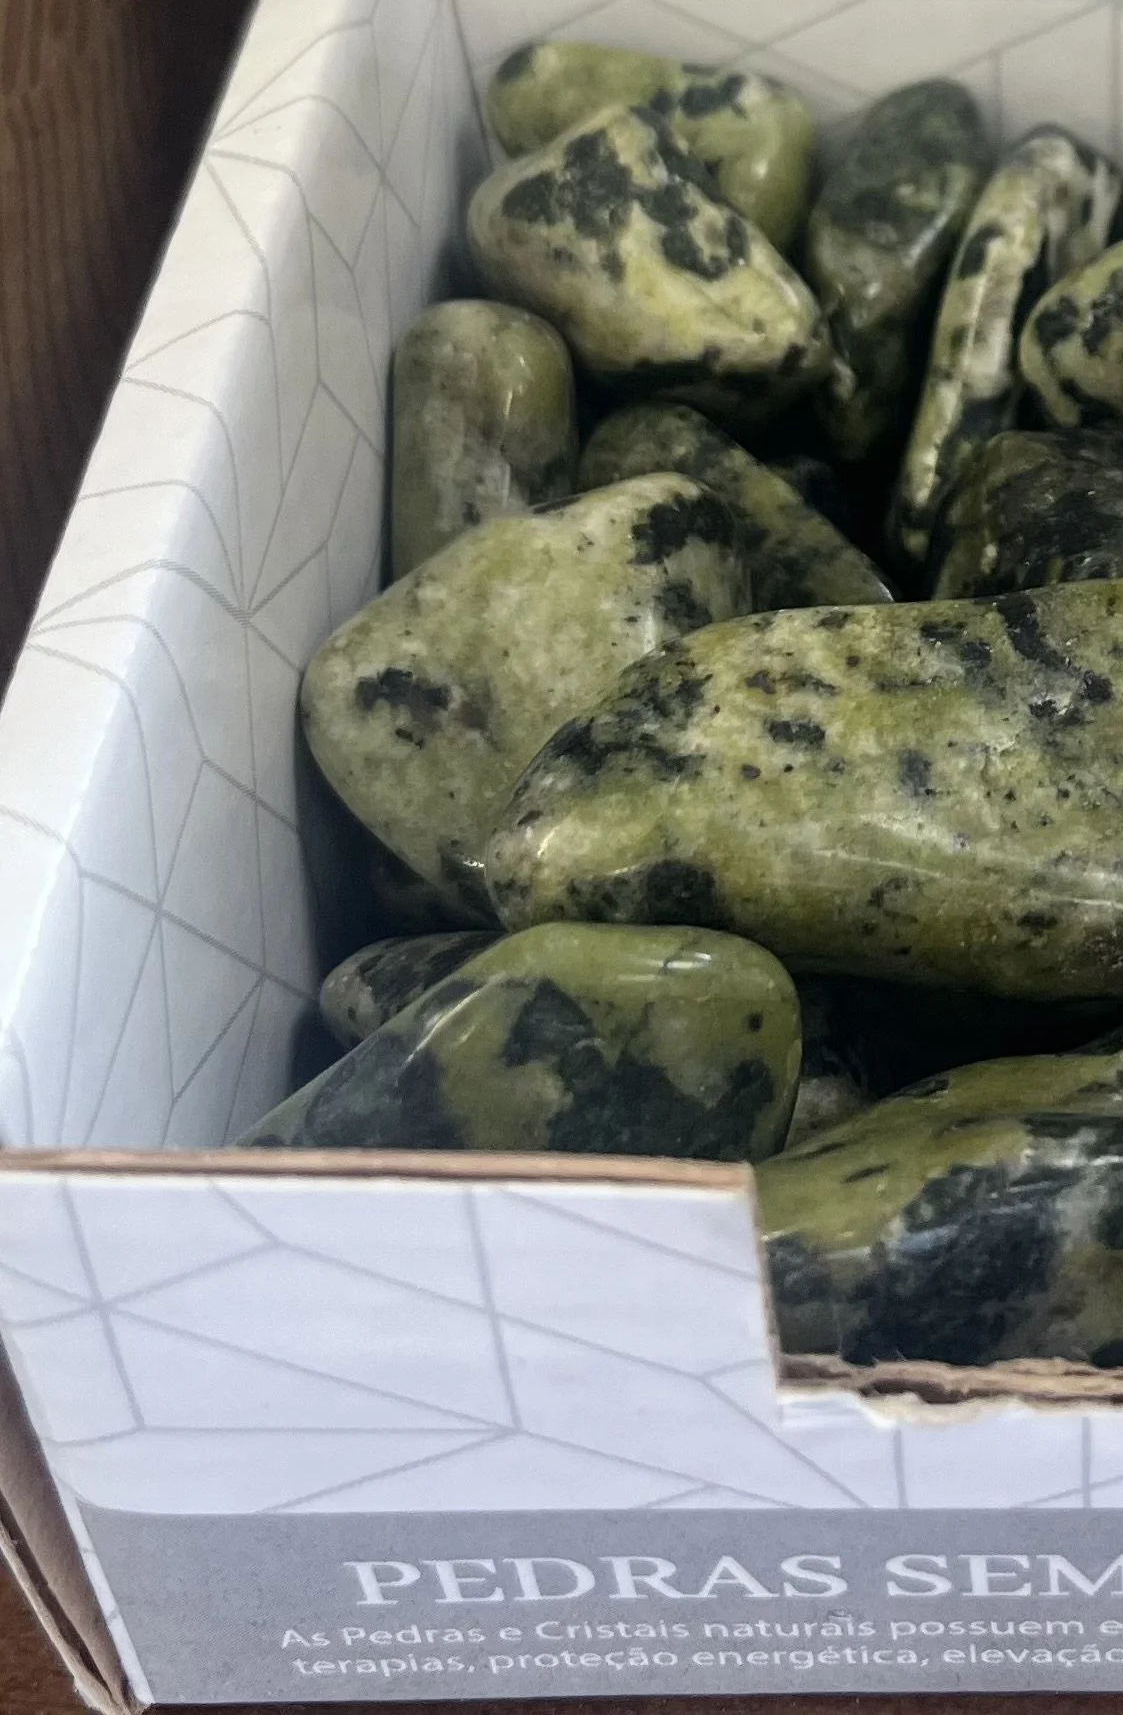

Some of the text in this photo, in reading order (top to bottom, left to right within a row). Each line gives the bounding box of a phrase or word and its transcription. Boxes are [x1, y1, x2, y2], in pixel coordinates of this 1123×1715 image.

[342, 1554, 848, 1606] PEDRAS
[280, 1629, 331, 1650] As
[339, 1624, 486, 1646] Pedras
[498, 1626, 523, 1642] e
[535, 1619, 691, 1641] Cristais
[890, 1620, 1085, 1641] possuem
[292, 1652, 476, 1677] terapias,
[487, 1646, 679, 1673] proteção
[691, 1644, 931, 1670] energética,
